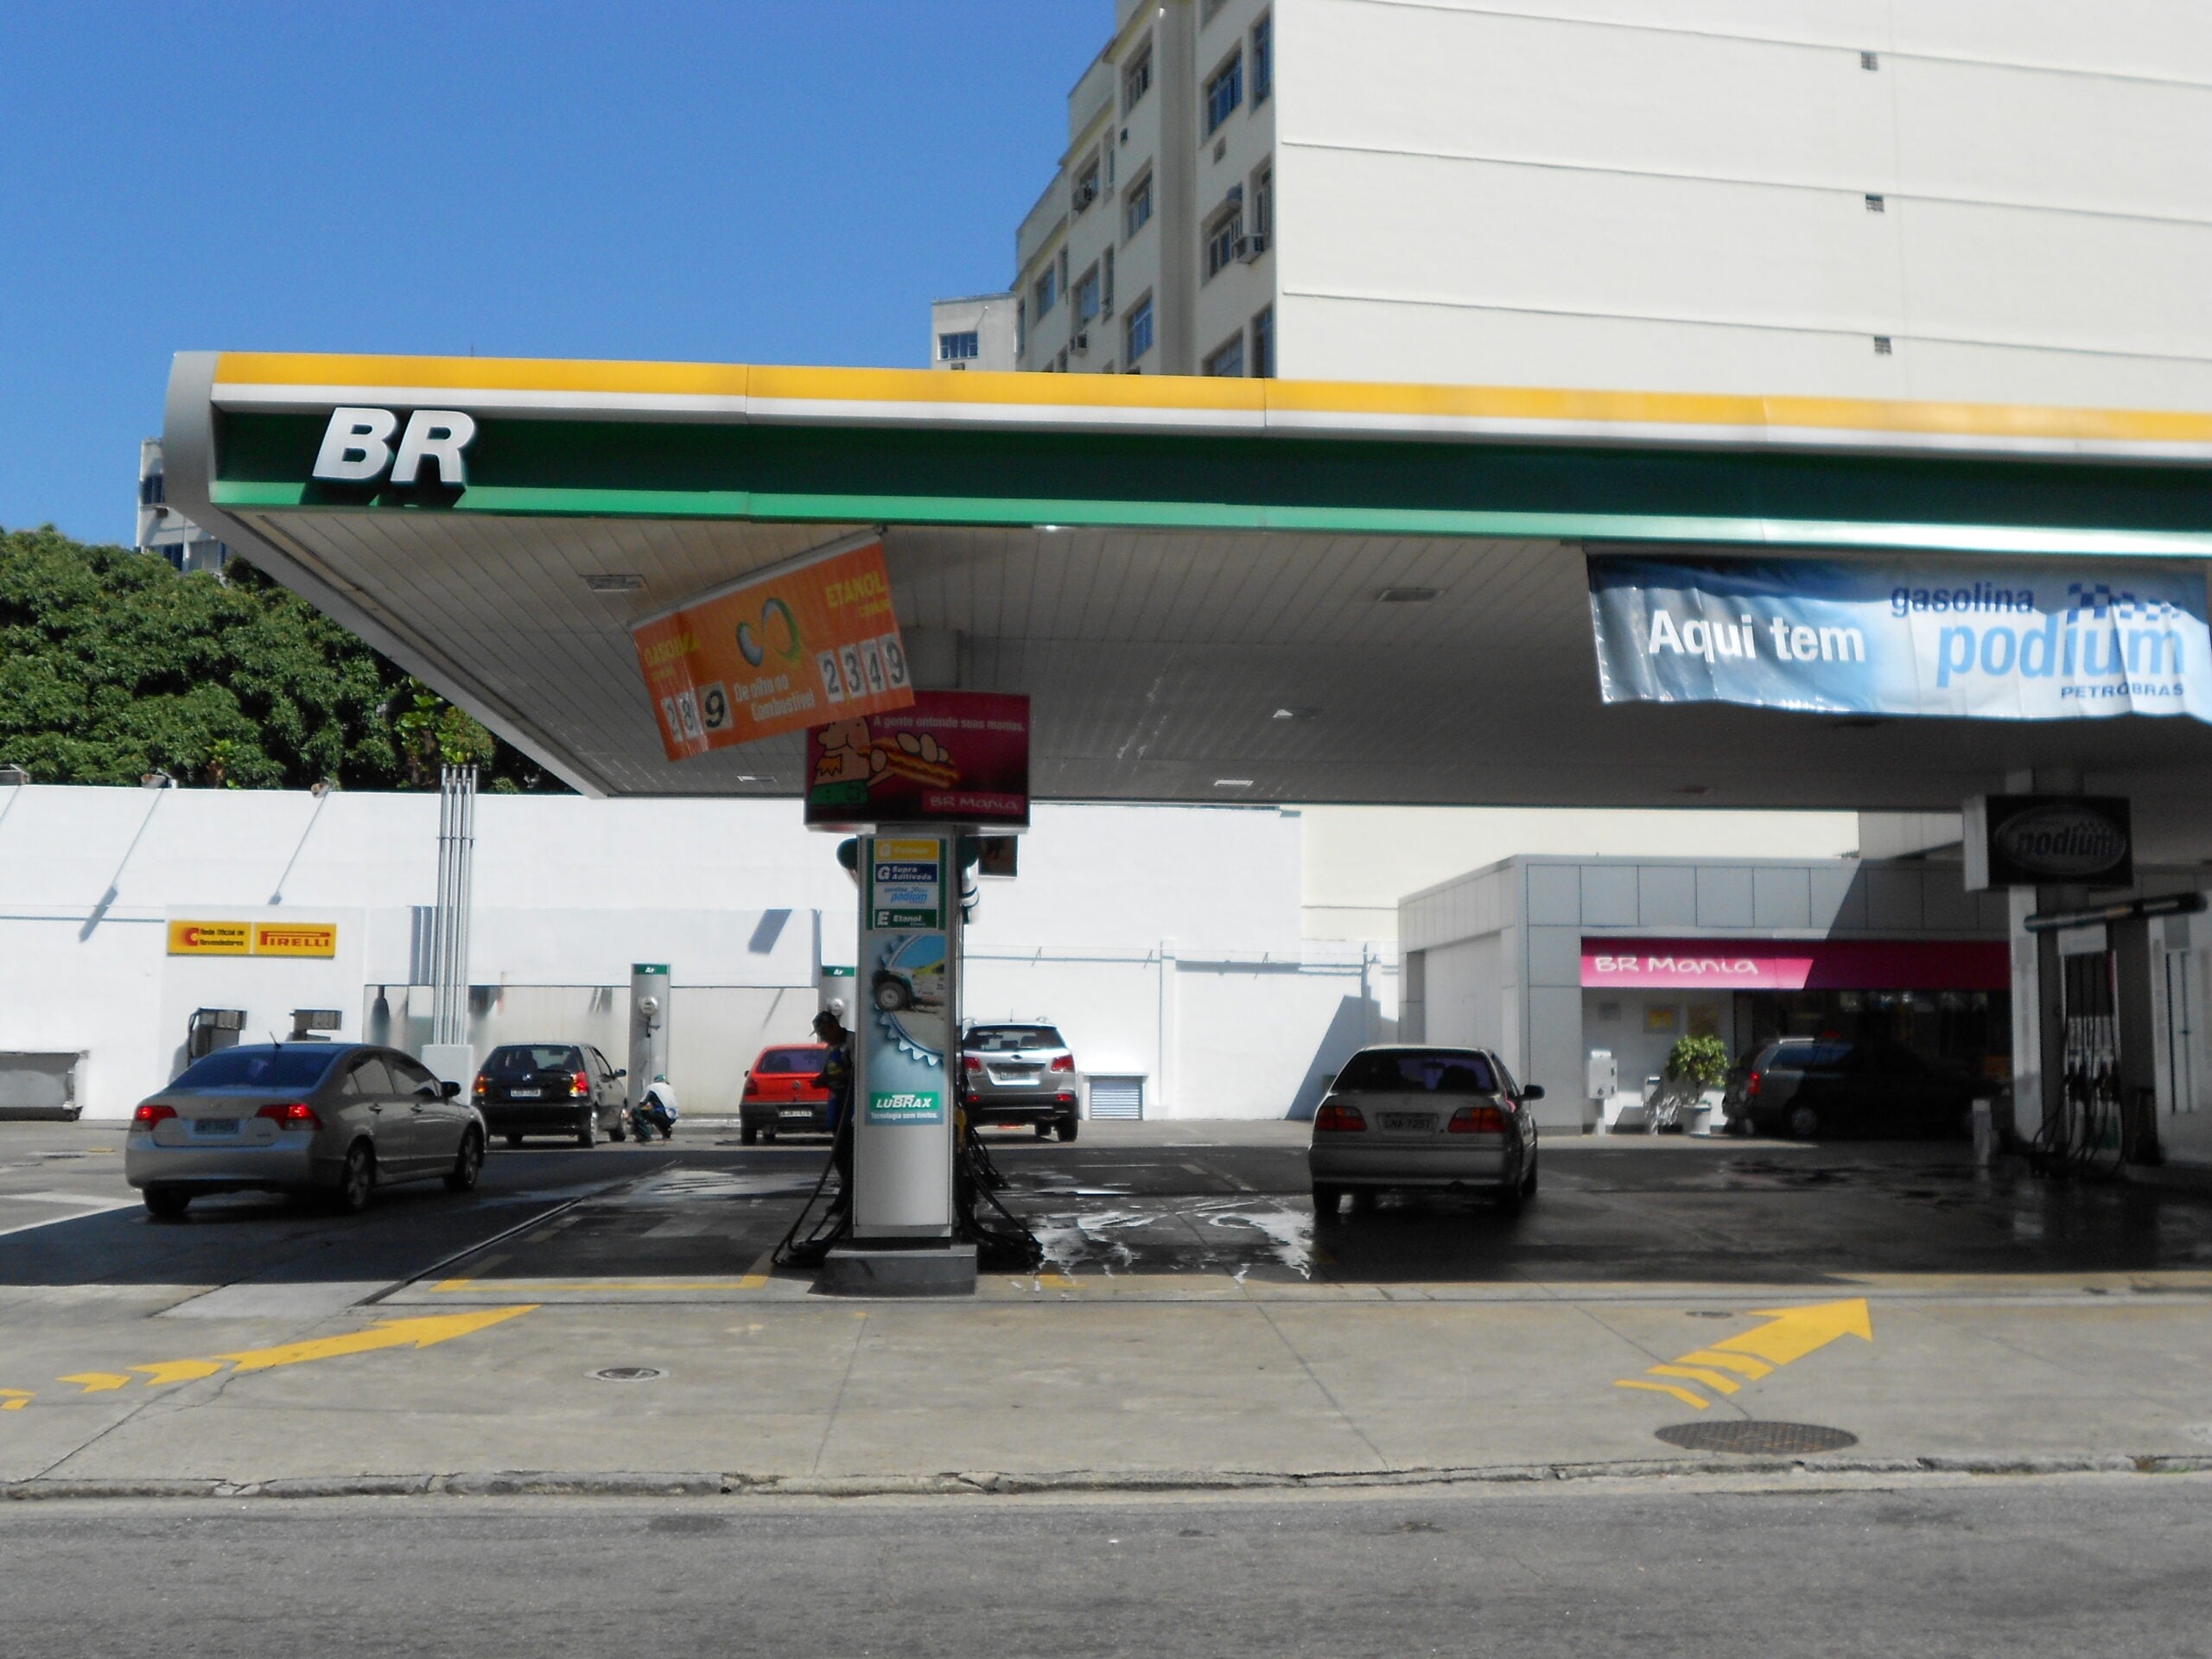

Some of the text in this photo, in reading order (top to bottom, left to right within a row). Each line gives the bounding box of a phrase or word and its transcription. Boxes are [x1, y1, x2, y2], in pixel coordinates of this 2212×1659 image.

[312, 407, 474, 482] BR
[825, 572, 886, 607] ETANOL
[1891, 582, 2034, 617] gasolina
[1649, 610, 1866, 663] Aqui tem
[1937, 613, 2185, 688] podium
[2062, 682, 2185, 699] PETROBRAS
[874, 716, 881, 727] A
[884, 716, 913, 728] gente
[916, 716, 958, 728] entende
[961, 719, 984, 729] suas
[930, 796, 1019, 811] BR Mania
[878, 866, 891, 880] G
[890, 892, 927, 904] podium
[877, 912, 889, 925] E
[260, 931, 331, 946] PIRELLI
[1595, 956, 1759, 976] BR Mania
[876, 1094, 932, 1109] LUBRAX
[871, 1112, 901, 1121] Tecnologia
